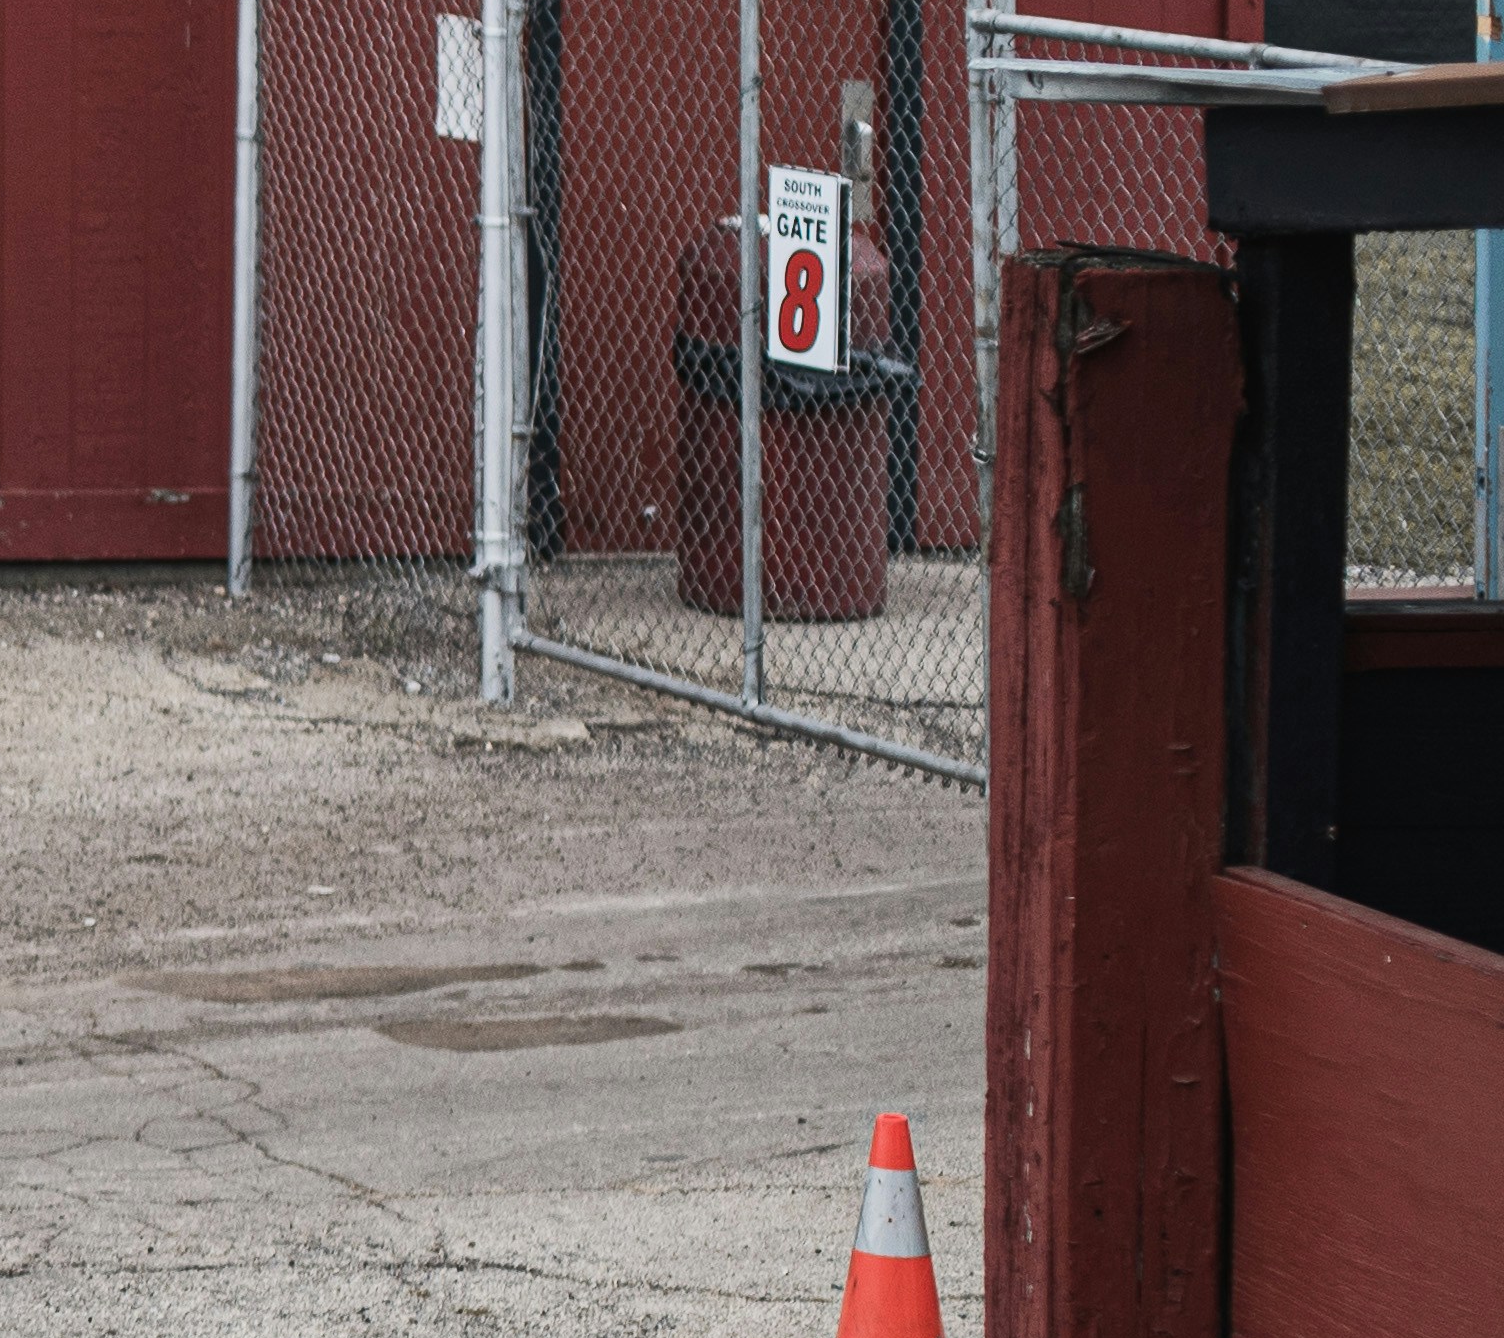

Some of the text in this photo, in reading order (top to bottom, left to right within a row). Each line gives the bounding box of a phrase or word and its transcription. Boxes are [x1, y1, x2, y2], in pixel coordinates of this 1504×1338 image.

[783, 179, 822, 198] SOUTH
[776, 197, 830, 216] CROSSOVER
[777, 213, 828, 244] GATE
[778, 249, 824, 353] 8
